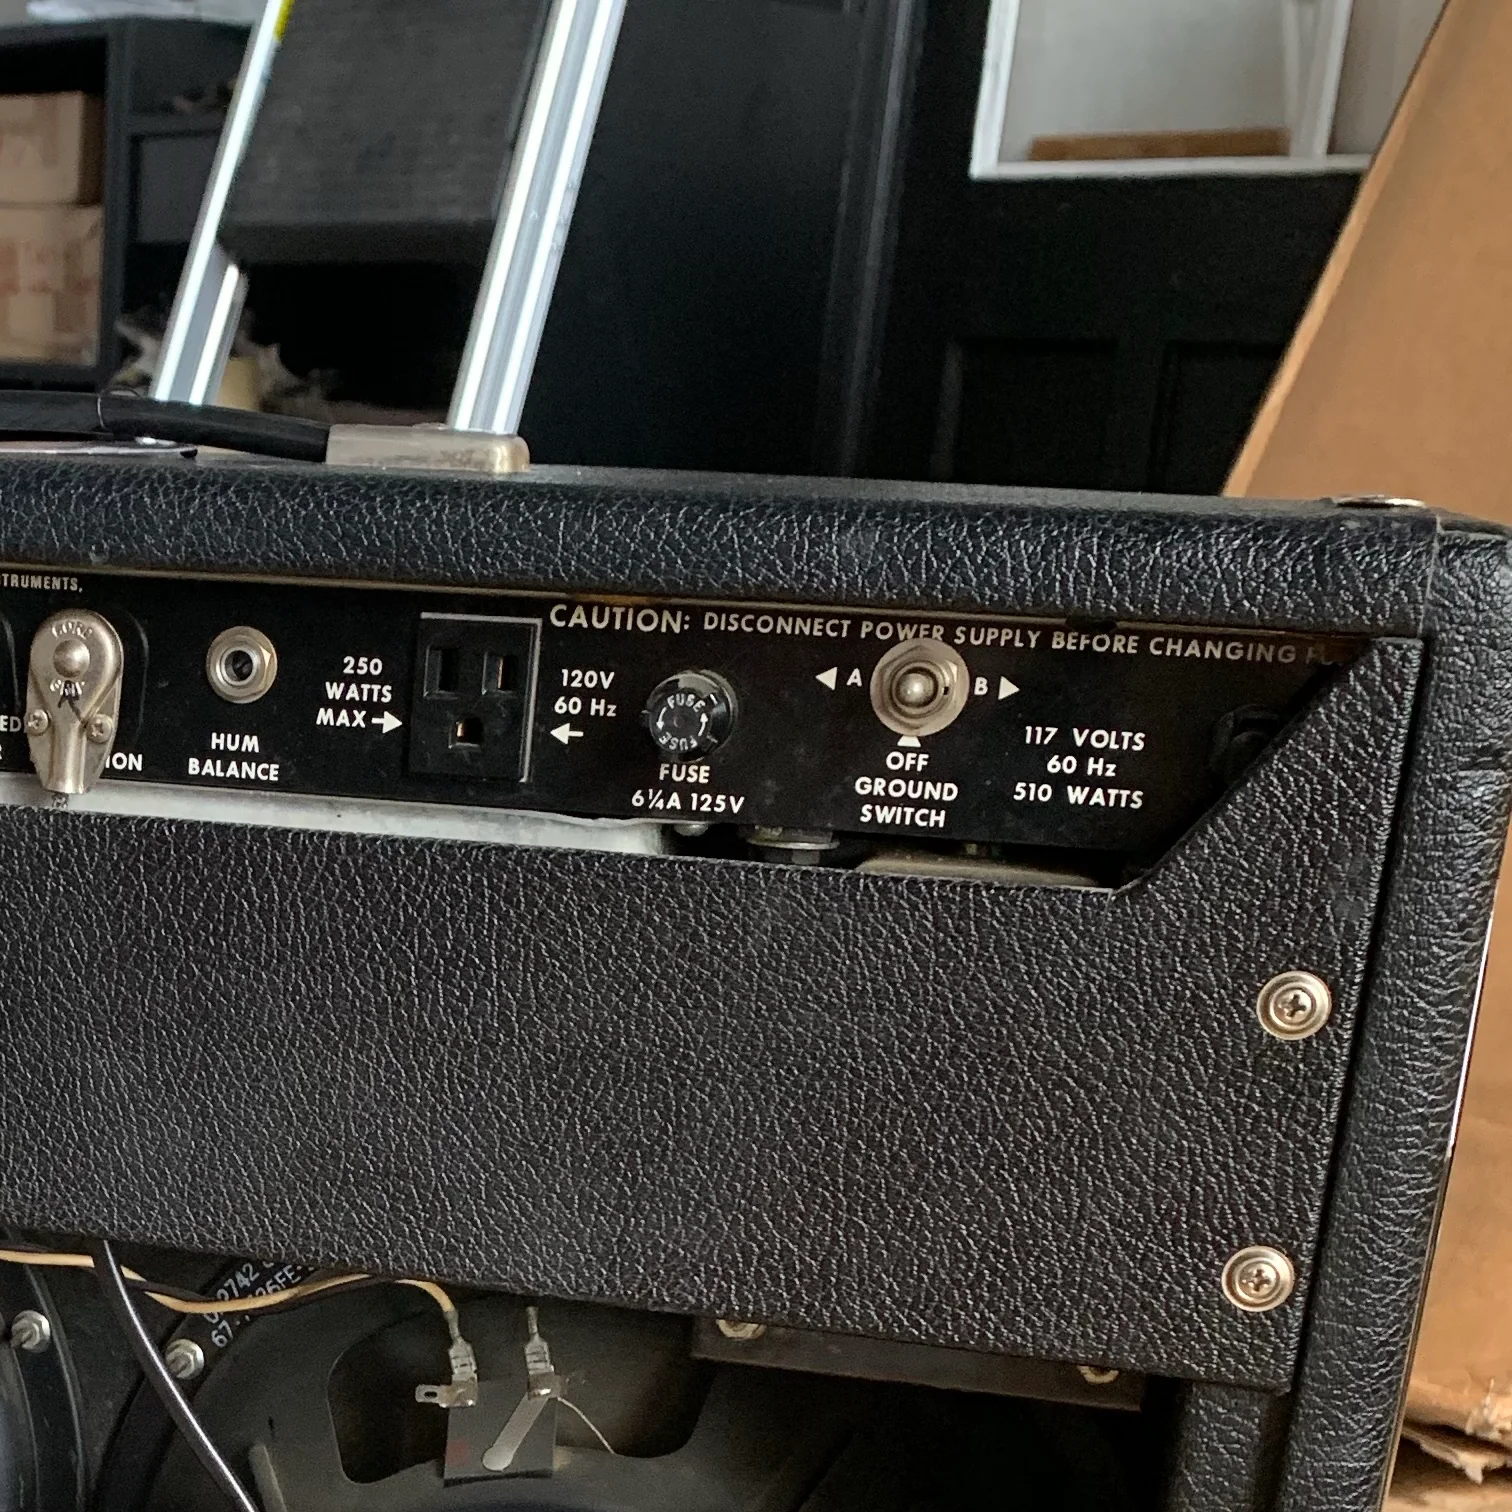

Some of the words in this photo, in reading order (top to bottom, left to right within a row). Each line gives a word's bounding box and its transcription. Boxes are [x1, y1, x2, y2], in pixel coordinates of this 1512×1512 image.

[549, 603, 691, 635] CAUTION:
[703, 611, 852, 639] DISCONNECT
[860, 620, 945, 642] POWER
[954, 626, 1042, 650] SUPPLY
[1051, 631, 1138, 655] BEFORE
[1149, 637, 1296, 663] CHANGING
[343, 656, 383, 676] 250
[561, 668, 615, 690] 120V
[846, 668, 862, 687] A
[974, 677, 988, 696] B
[325, 681, 392, 703] WATTS
[667, 693, 706, 713] FUSE
[316, 707, 367, 728] MAX
[554, 696, 582, 716] 60
[590, 698, 617, 718] Hz
[210, 732, 260, 753] HUM
[1024, 725, 1058, 746] 117
[1073, 727, 1146, 752] VOLTS
[188, 758, 280, 782] BALANCE
[659, 763, 711, 783] FUSE
[886, 751, 929, 773] OFF
[1046, 755, 1078, 775] 60
[1087, 757, 1117, 778] Hz
[854, 776, 959, 802] GROUND
[1013, 782, 1052, 803] 510
[1066, 785, 1144, 809] WATTS
[691, 793, 745, 814] 125V
[860, 803, 946, 829] SWITCH
